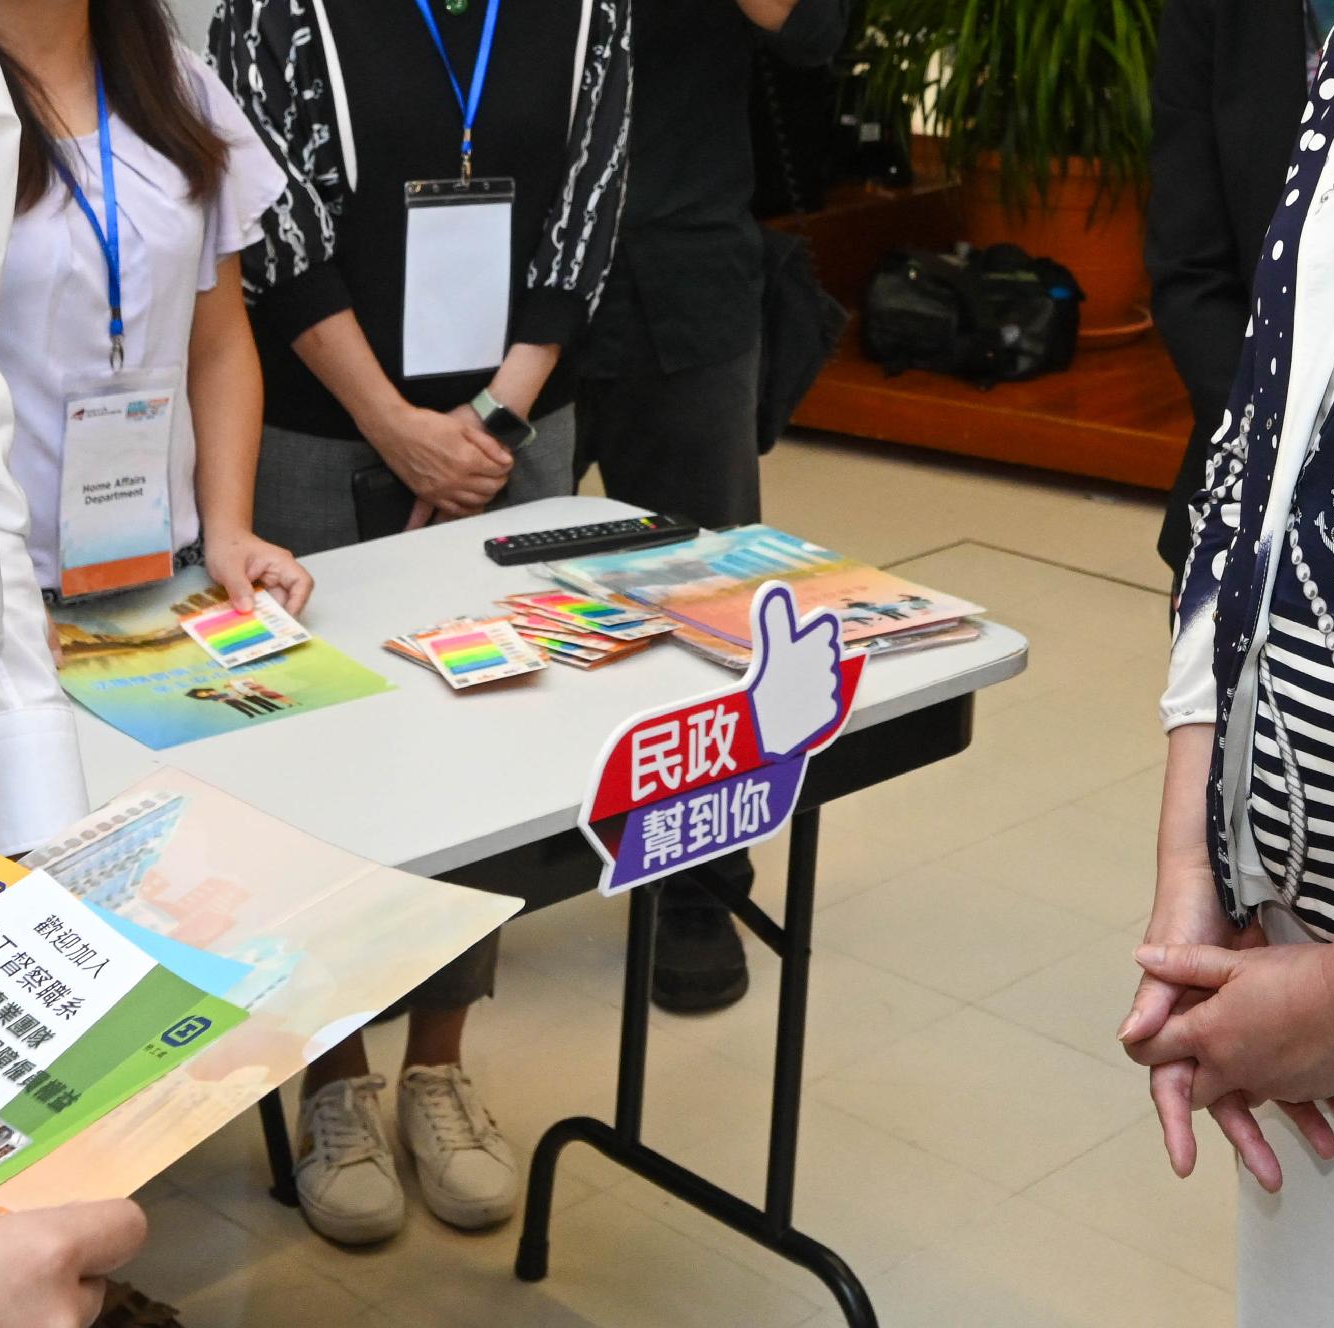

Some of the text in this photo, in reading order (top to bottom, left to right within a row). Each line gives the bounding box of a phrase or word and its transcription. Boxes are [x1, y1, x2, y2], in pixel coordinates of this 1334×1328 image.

[83, 475, 146, 494] Home Affairs
[84, 487, 144, 505] Department
[631, 704, 739, 802] 民政
[642, 778, 771, 870] 幫到你
[32, 913, 110, 979] 歡迎加入
